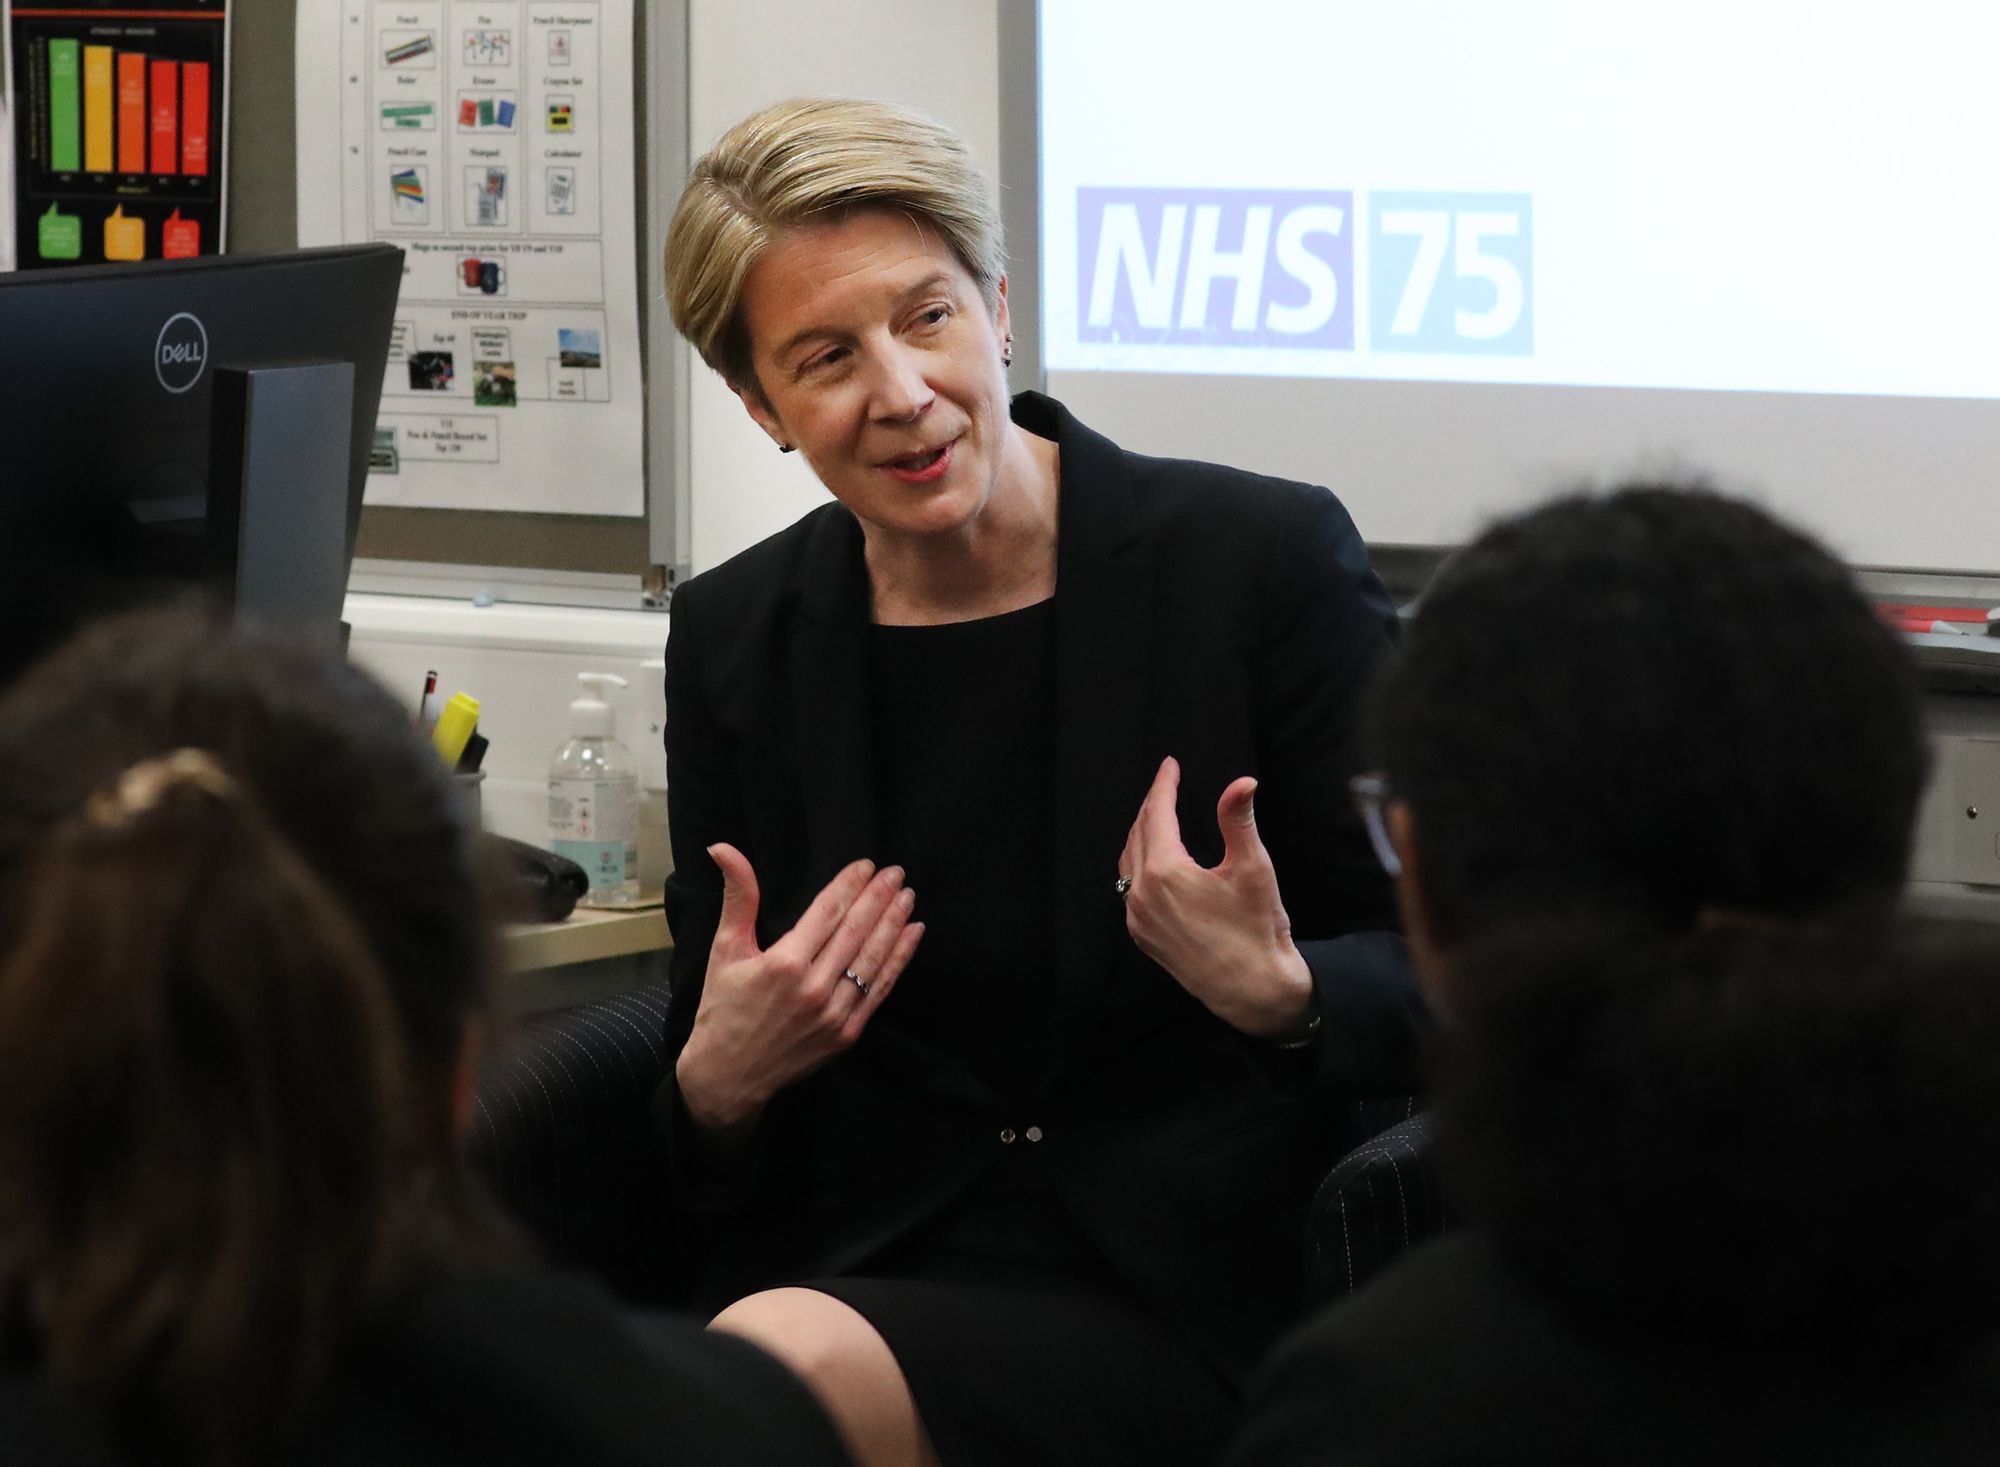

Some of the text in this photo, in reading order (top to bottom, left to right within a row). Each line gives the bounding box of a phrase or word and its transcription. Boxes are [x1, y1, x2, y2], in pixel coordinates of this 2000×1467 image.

[1087, 203, 1525, 339] NHS 75
[162, 342, 201, 364] DELL
